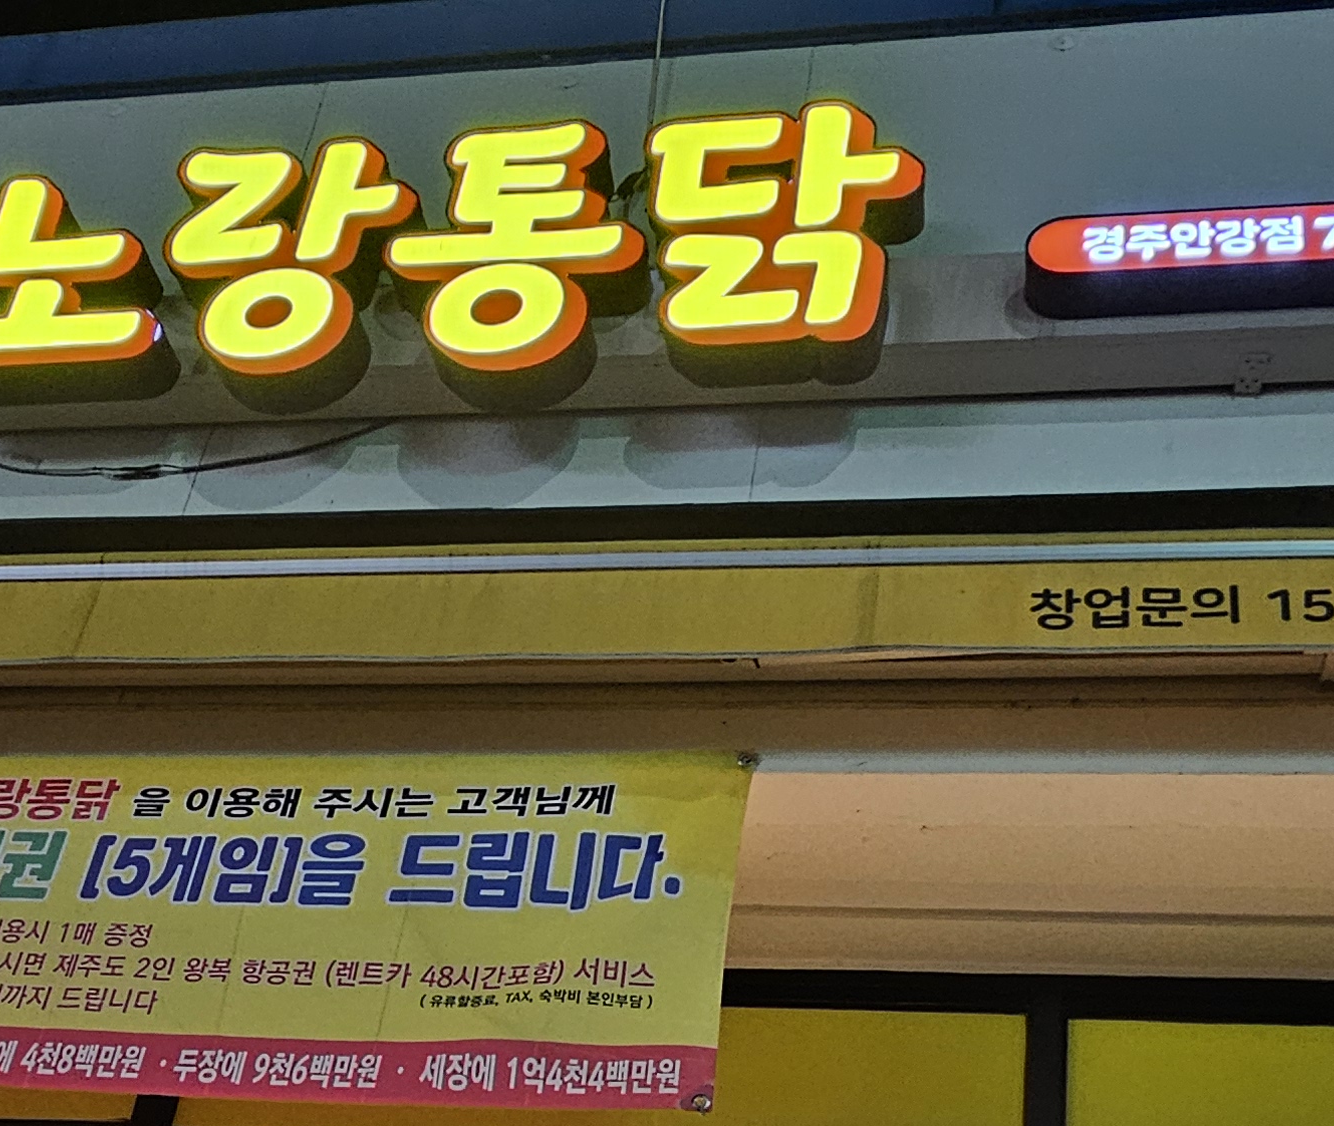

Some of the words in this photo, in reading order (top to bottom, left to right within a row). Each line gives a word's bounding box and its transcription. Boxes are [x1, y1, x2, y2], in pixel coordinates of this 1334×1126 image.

[1082, 214, 1305, 263] 경주안강점
[1029, 584, 1242, 632] 창업문의
[132, 786, 172, 818] 을
[184, 785, 303, 819] 이용해
[313, 786, 436, 819] 주시는
[447, 784, 617, 818] 고객님께
[78, 831, 367, 905] [5게임]을
[387, 830, 682, 911] 드립니다.
[58, 920, 96, 946] 1매
[102, 922, 154, 949] 증정
[52, 952, 127, 979] 제주도
[133, 956, 177, 981] 2인
[182, 957, 232, 984] 왕복
[242, 957, 317, 987] 항공권
[324, 958, 413, 989] (렌트카
[419, 959, 566, 991] 48시간포함)
[572, 957, 656, 989] 서비스
[58, 986, 159, 1016] 드립니다
[539, 988, 582, 1005] 숙박비
[20, 1041, 147, 1081] 4천8백만원
[173, 1047, 247, 1086] 두장에
[252, 1051, 384, 1091] 9천6백만원
[419, 1053, 498, 1092] 세장에
[507, 1055, 681, 1096] 1억4천4백만원
